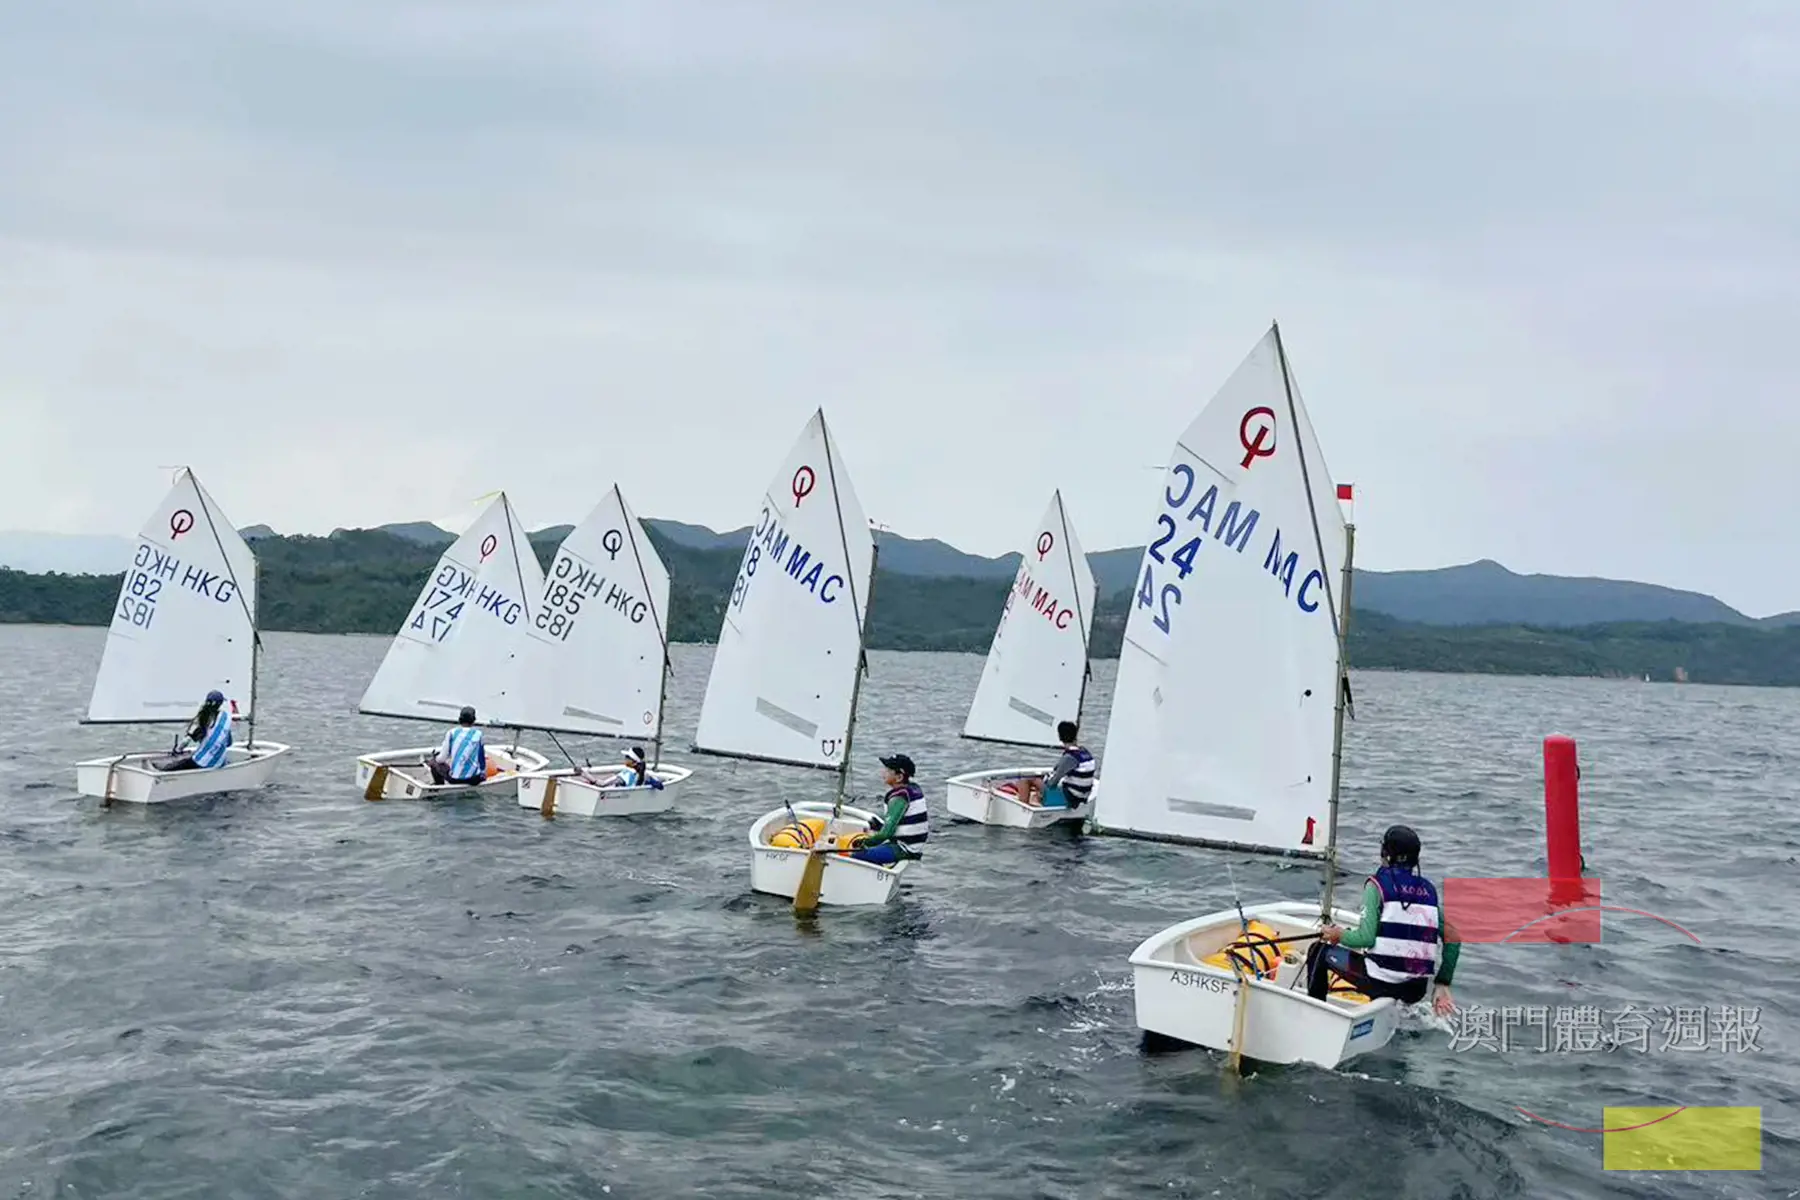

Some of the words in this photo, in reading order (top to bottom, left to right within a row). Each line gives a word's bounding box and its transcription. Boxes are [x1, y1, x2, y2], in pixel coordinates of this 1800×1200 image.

[1149, 513, 1202, 580] 24
[126, 570, 163, 603] 182
[181, 565, 237, 602] HKG
[785, 544, 844, 604] MAC
[1264, 527, 1323, 613] MAC
[423, 587, 465, 620] 174
[475, 585, 522, 625] HKG
[544, 580, 585, 615] 185
[604, 584, 648, 624] HKG
[1031, 587, 1073, 629] MAC
[1170, 971, 1230, 994] A3HKSF
